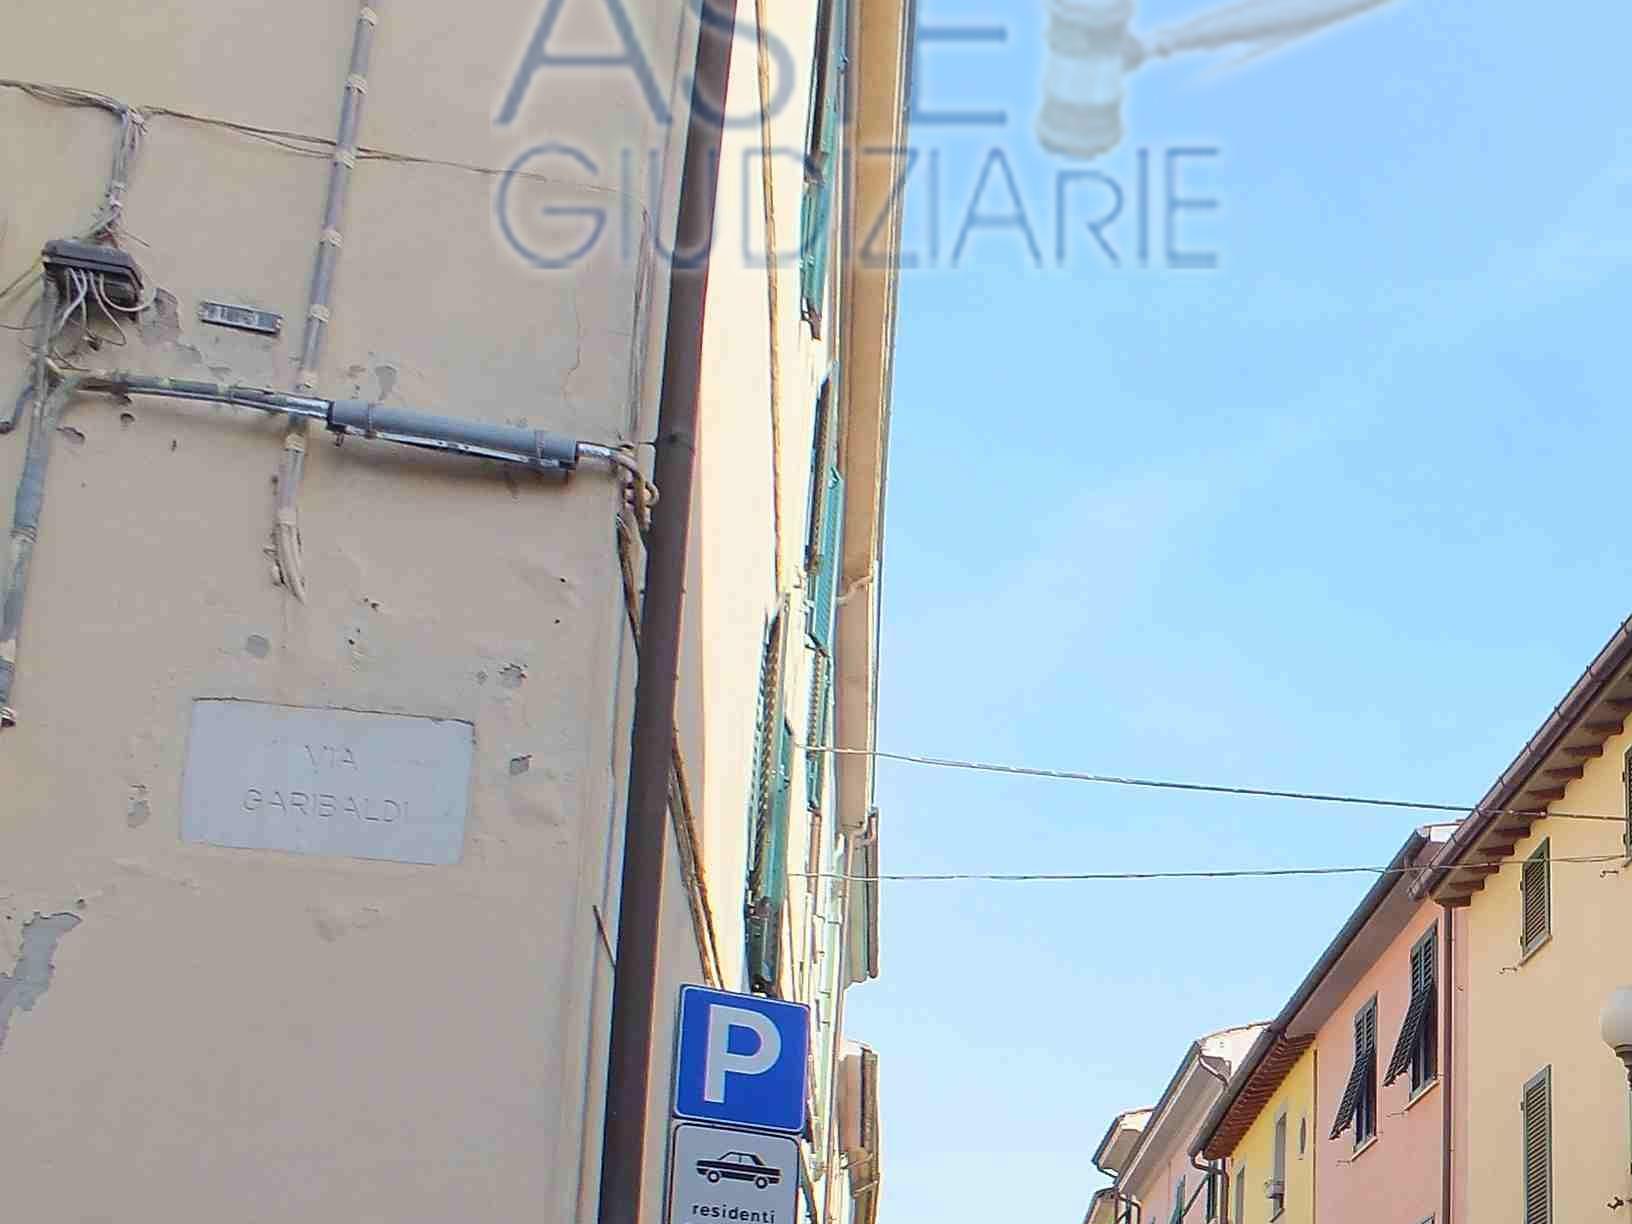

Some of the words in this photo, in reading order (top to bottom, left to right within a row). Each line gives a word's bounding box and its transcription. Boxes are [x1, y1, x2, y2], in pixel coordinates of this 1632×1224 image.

[303, 743, 359, 772] VIA
[242, 785, 410, 825] GARIBALDI
[704, 1003, 782, 1104] P
[692, 1203, 776, 1224] residenti
